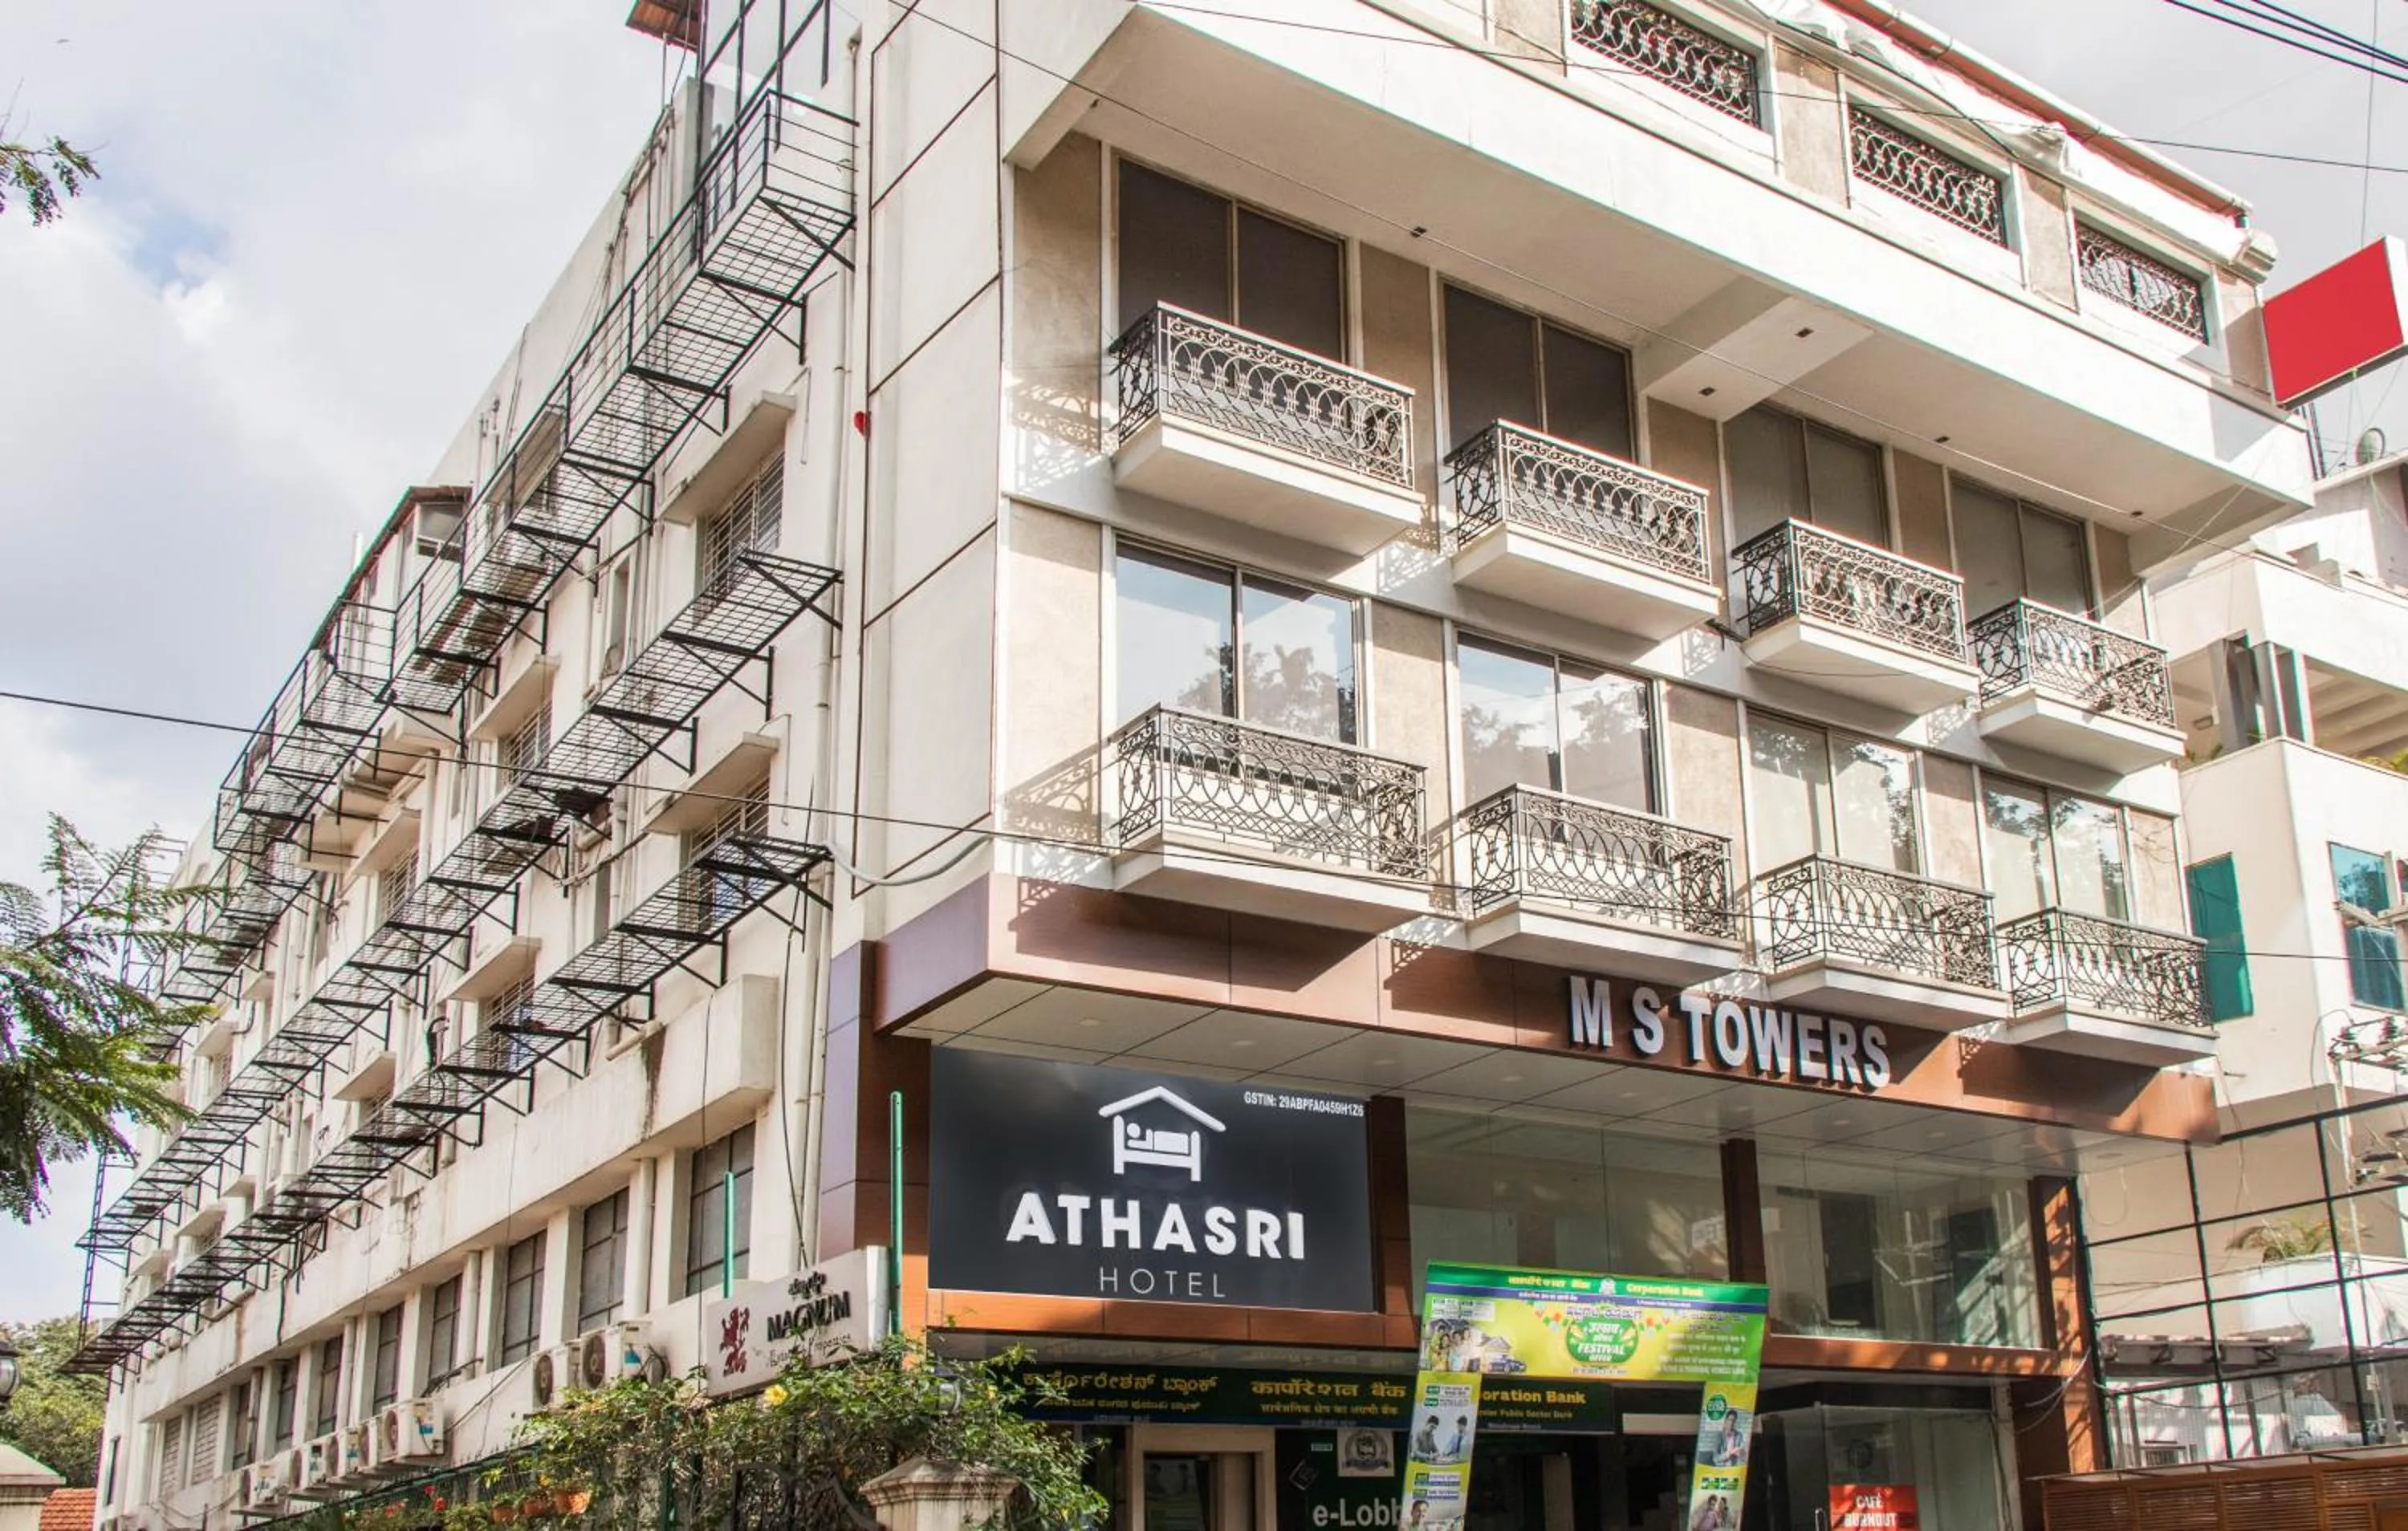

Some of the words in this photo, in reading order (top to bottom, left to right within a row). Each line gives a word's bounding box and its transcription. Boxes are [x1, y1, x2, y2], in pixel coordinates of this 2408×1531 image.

[1568, 975, 1613, 1047] M
[1631, 986, 1664, 1056] S
[1679, 989, 1891, 1090] TOWERS
[1244, 1090, 1277, 1107] GSTIN:
[1006, 1192, 1305, 1260] ATHASRI
[1099, 1266, 1226, 1297] HOTEL
[767, 1290, 852, 1342] MAGNUM
[1577, 1342, 1625, 1355] FESTIVAL
[1480, 1389, 1541, 1403] oration
[1546, 1390, 1587, 1404] Bank
[1312, 1497, 1403, 1528] e-Lobb
